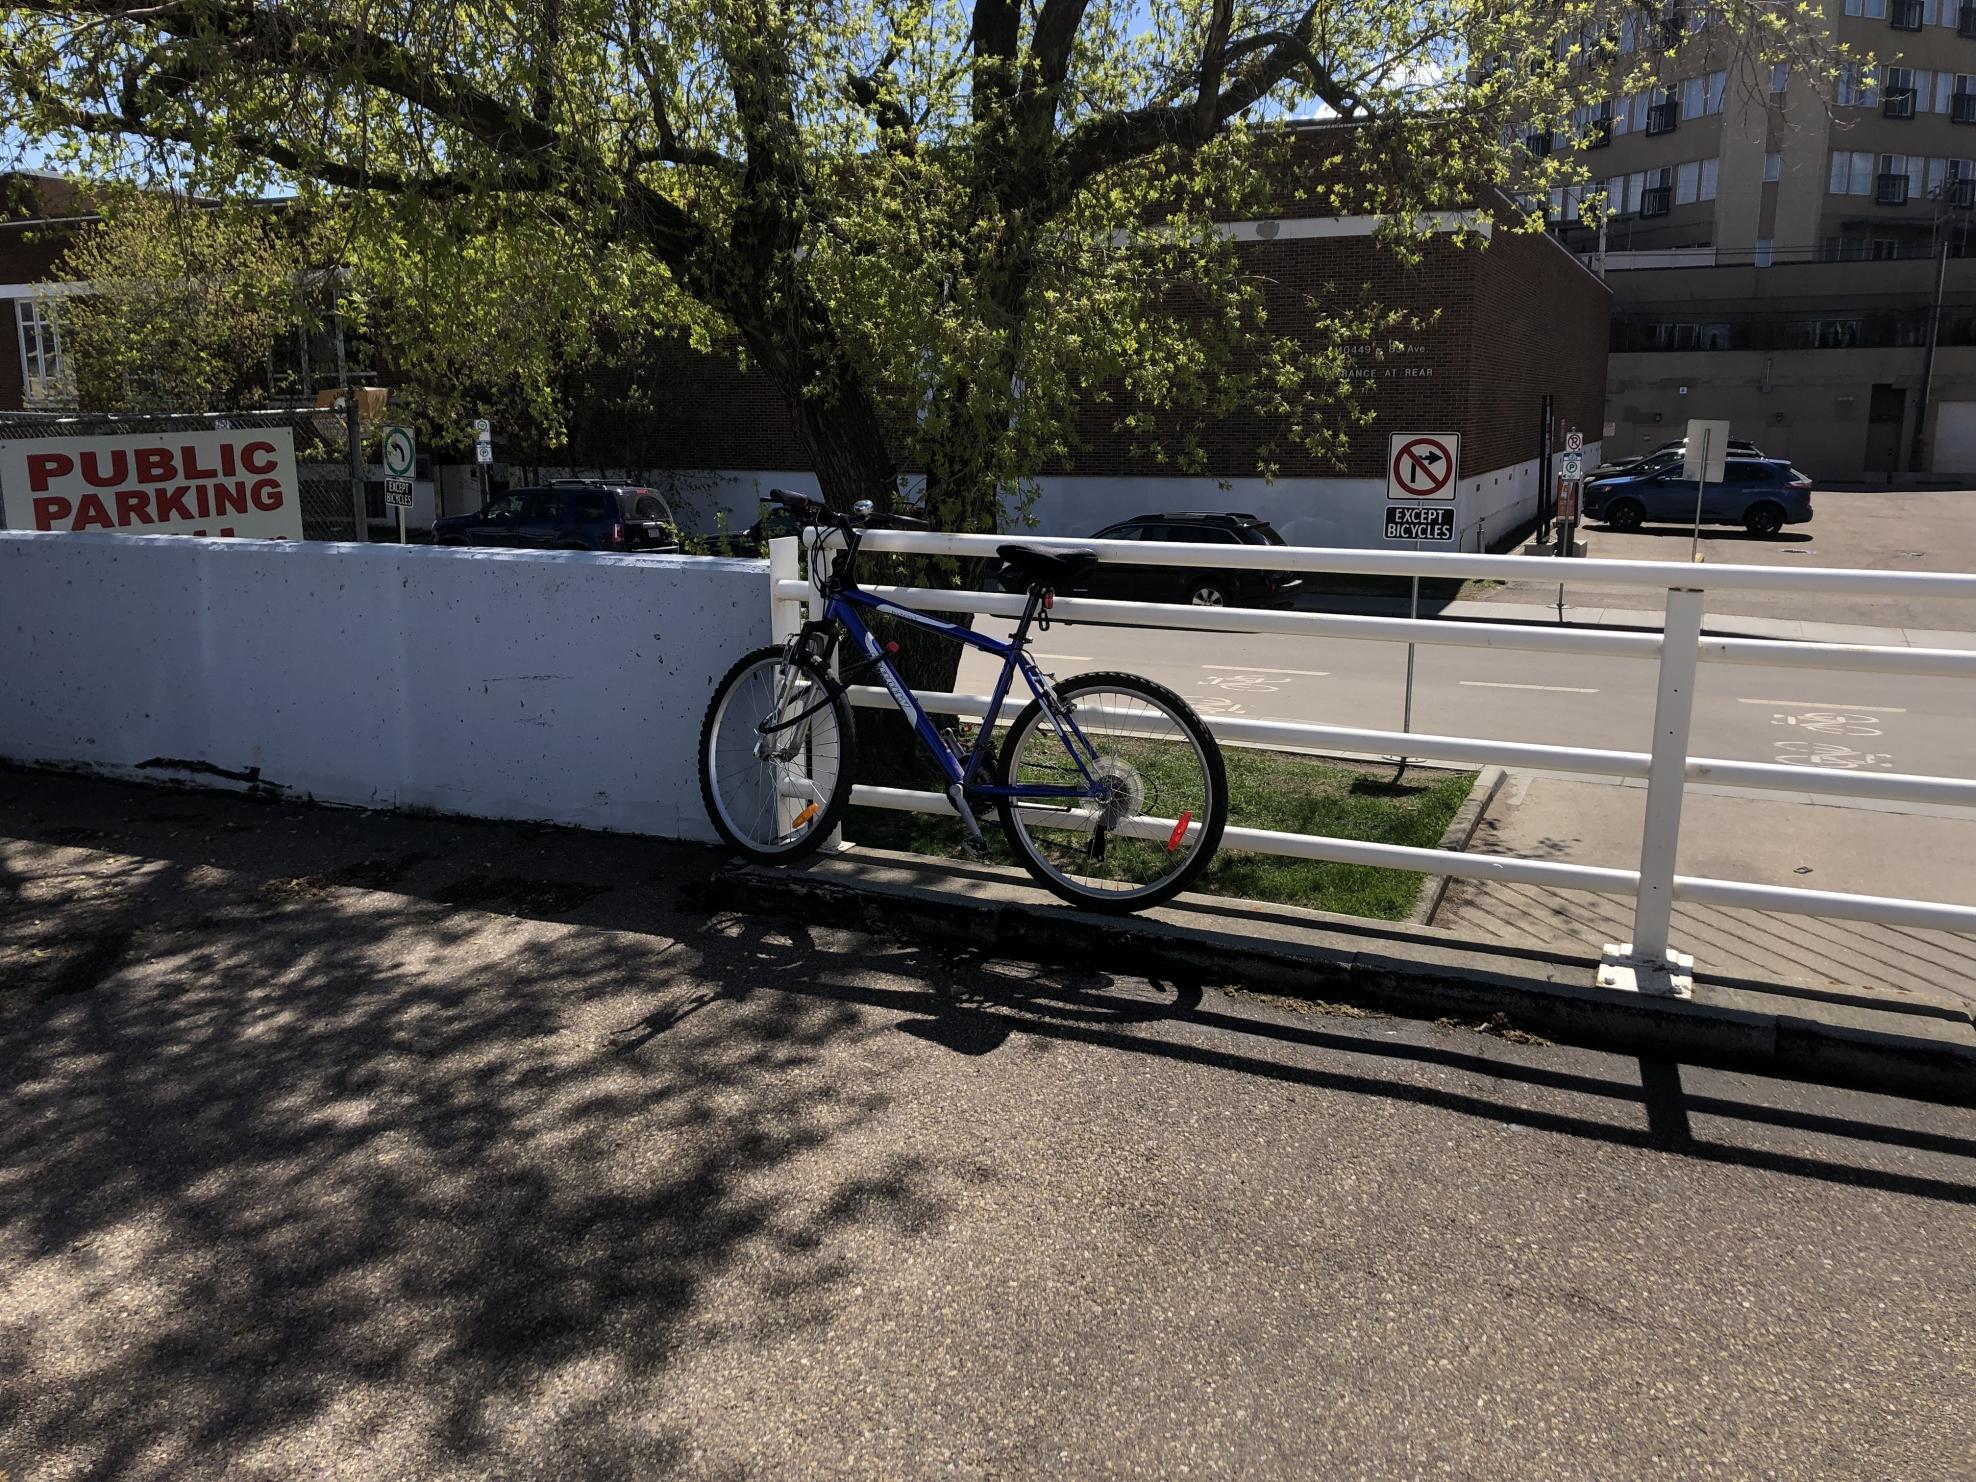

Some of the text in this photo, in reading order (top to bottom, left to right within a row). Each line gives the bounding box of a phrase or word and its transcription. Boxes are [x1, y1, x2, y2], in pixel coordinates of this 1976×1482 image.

[1341, 368, 1433, 378] RANCE AT REAR
[26, 440, 279, 492] PUBLIC
[389, 481, 409, 493] EXCEPT
[33, 477, 284, 531] PARKING
[387, 492, 411, 505] BICYCLES
[1395, 508, 1444, 523] EXCEPT
[1387, 523, 1450, 539] BICYCLES
